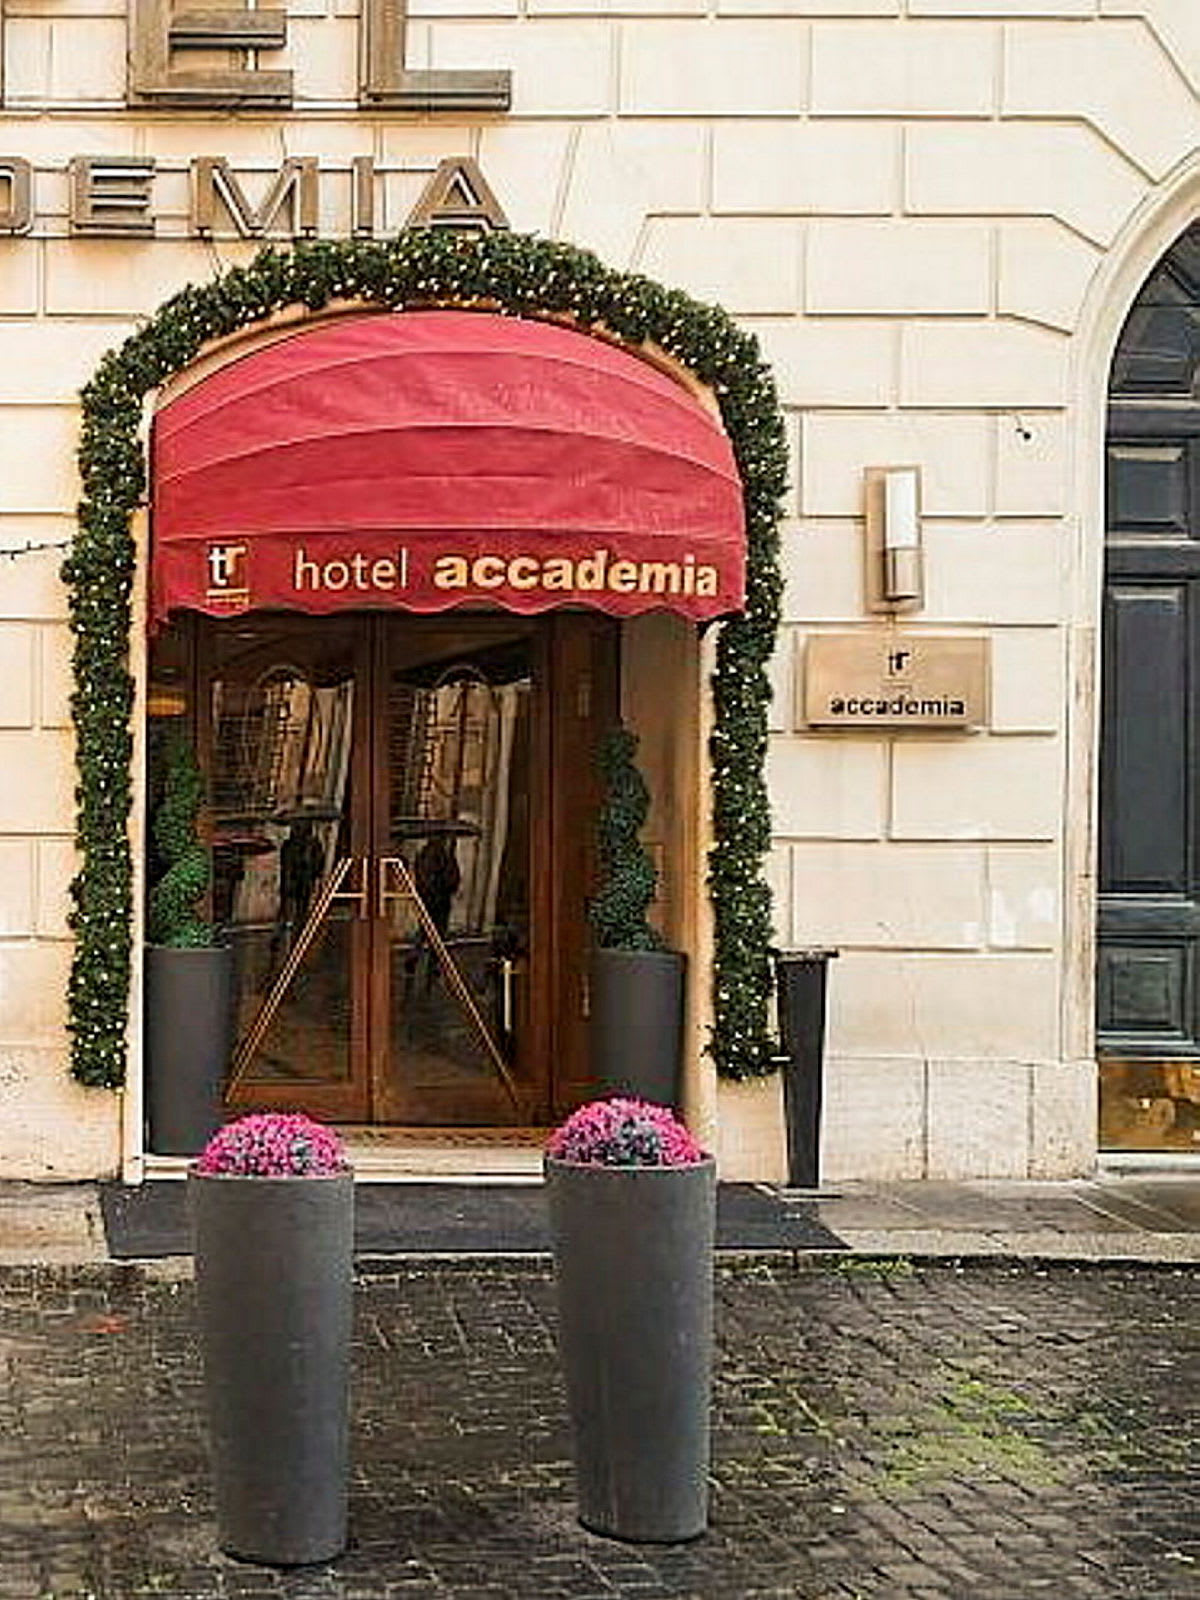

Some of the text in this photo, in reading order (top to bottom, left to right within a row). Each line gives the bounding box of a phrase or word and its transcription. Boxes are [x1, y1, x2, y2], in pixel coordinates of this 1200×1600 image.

[295, 548, 718, 597] hotel accademia
[830, 694, 965, 716] accademia
